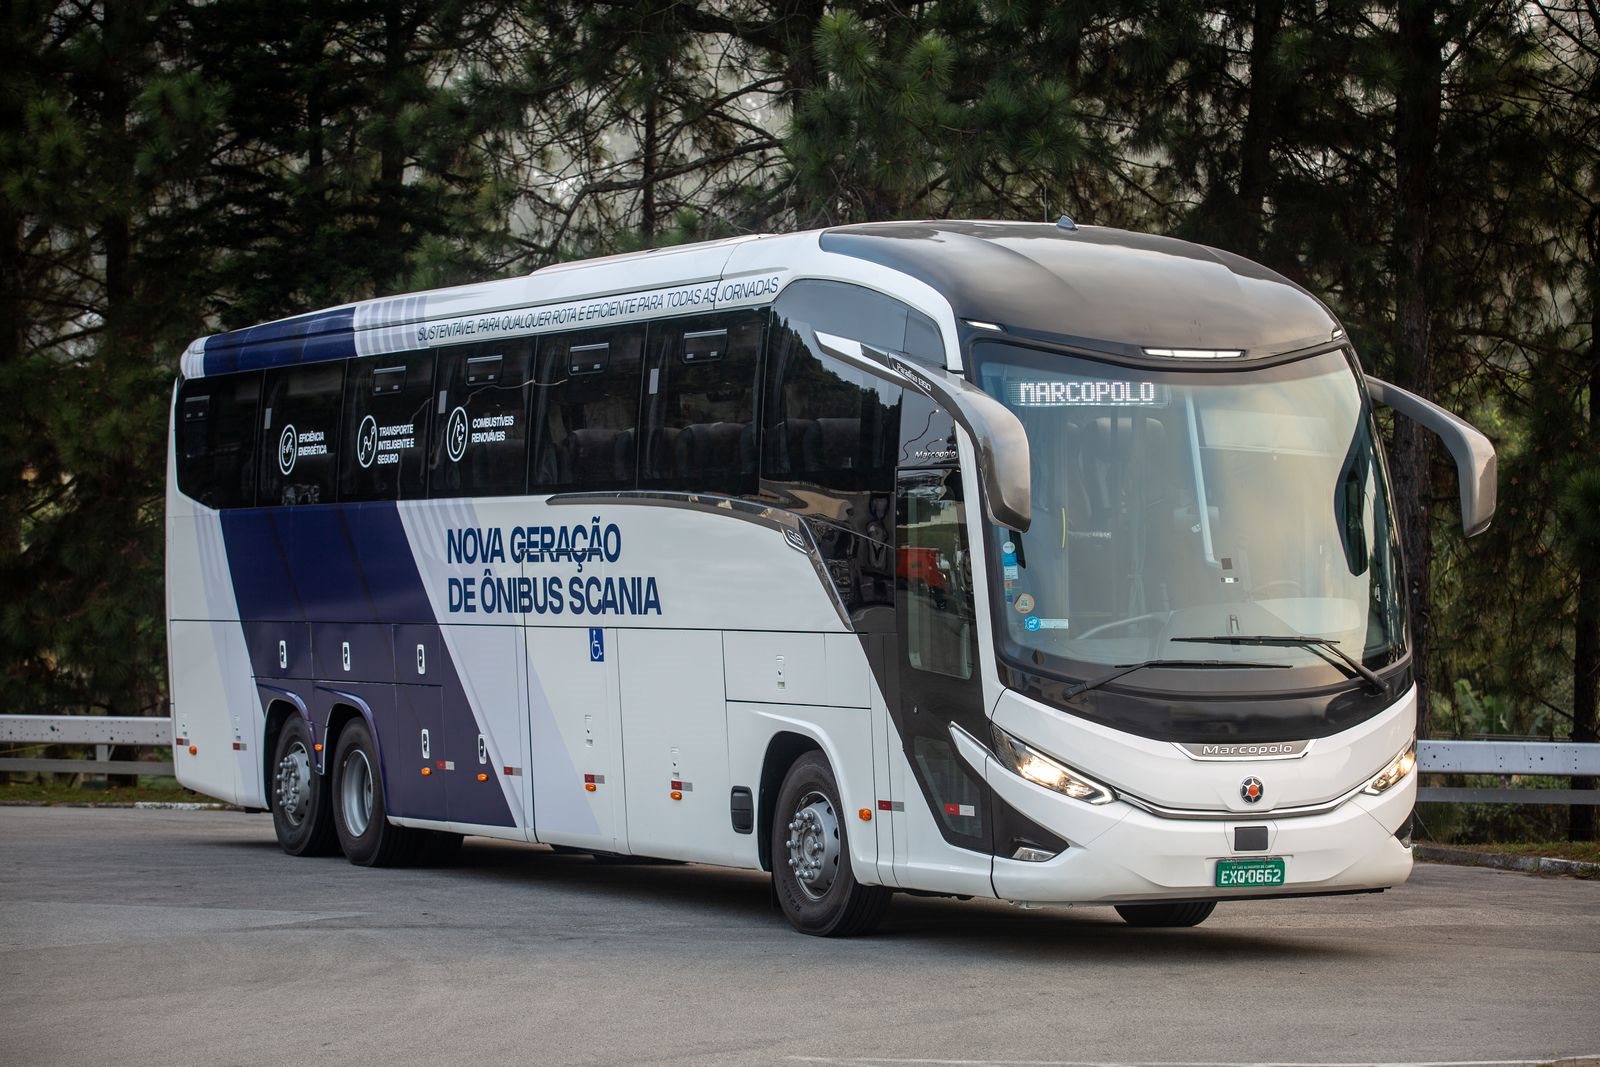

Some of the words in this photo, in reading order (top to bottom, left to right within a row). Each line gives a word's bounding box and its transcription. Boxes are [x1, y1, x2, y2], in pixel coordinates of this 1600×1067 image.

[417, 320, 476, 342] SUSTENTÁVEL
[477, 317, 500, 333] PARA
[501, 311, 551, 330] QUALQUER
[552, 308, 577, 325] ROTA
[578, 306, 587, 321] E
[586, 298, 637, 320] EFICIENTE
[637, 294, 664, 311] PARA
[667, 289, 702, 308] TODAS
[702, 286, 717, 303] AS
[718, 277, 779, 302] JORNADAS
[1020, 382, 1154, 402] MARCOPOLO
[472, 414, 514, 429] COMBUSTÍVEIS
[298, 430, 325, 443] EFICIÊNCIA
[379, 424, 414, 437] TRANSPORTE
[471, 430, 506, 443] RENOVÁVEIS
[297, 443, 328, 457] ENERGÉTICA
[378, 438, 410, 451] INTELIGENTE
[410, 438, 415, 448] E
[377, 453, 399, 464] SEGURO
[915, 450, 956, 459] Marcopolo
[447, 527, 506, 564] NOVA
[510, 516, 622, 573] GERAÇÃO
[448, 577, 477, 613] DE
[480, 568, 564, 615] ÔNIBUS
[568, 576, 662, 615] SCANIA
[1202, 744, 1293, 755] Marcopolo
